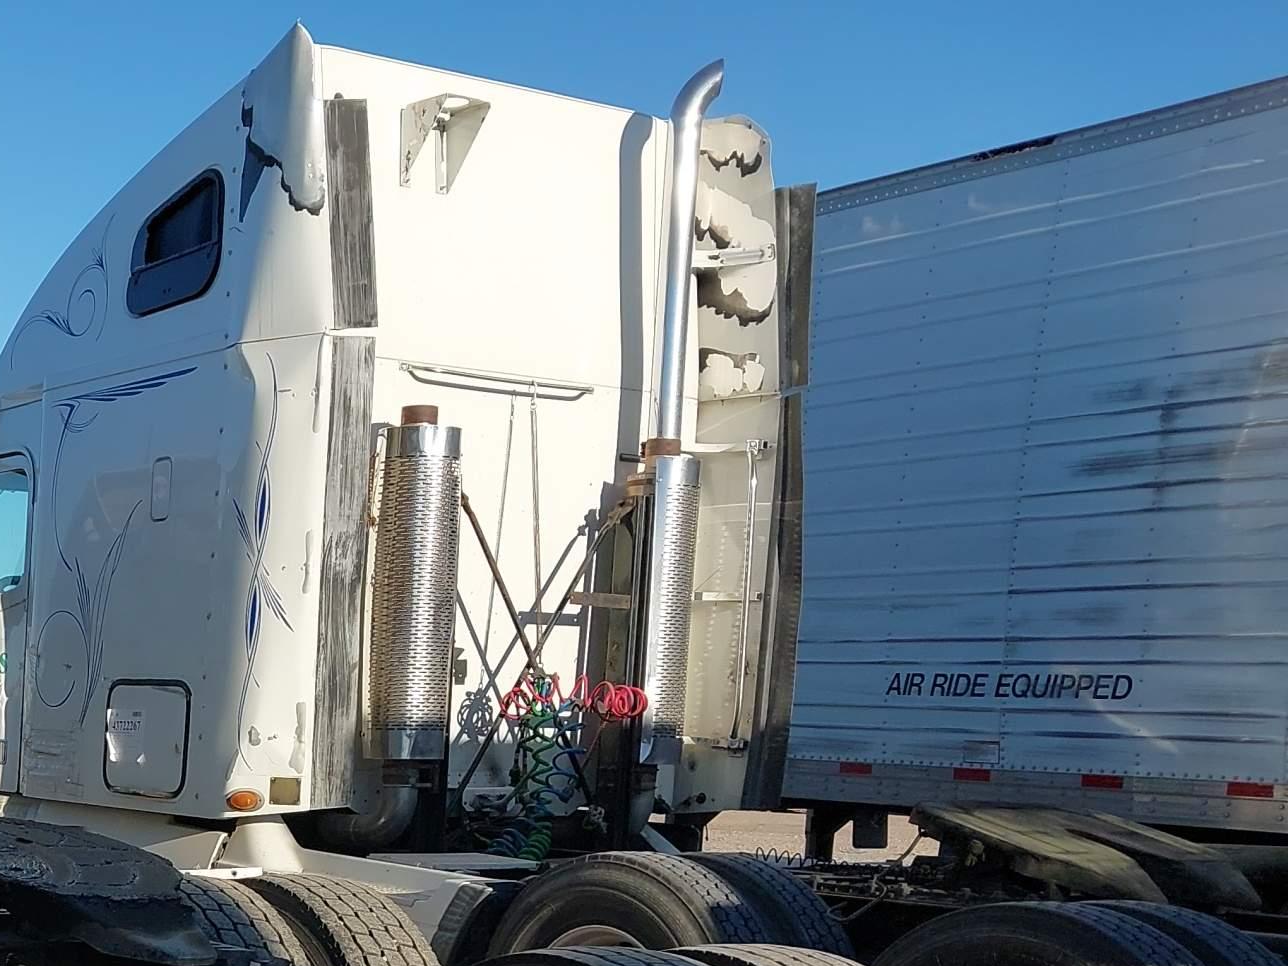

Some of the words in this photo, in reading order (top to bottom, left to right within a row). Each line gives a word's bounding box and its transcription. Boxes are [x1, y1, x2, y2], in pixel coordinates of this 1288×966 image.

[886, 672, 925, 696] AIR
[930, 673, 989, 697] RIDE
[994, 673, 1133, 700] EQUIPPED
